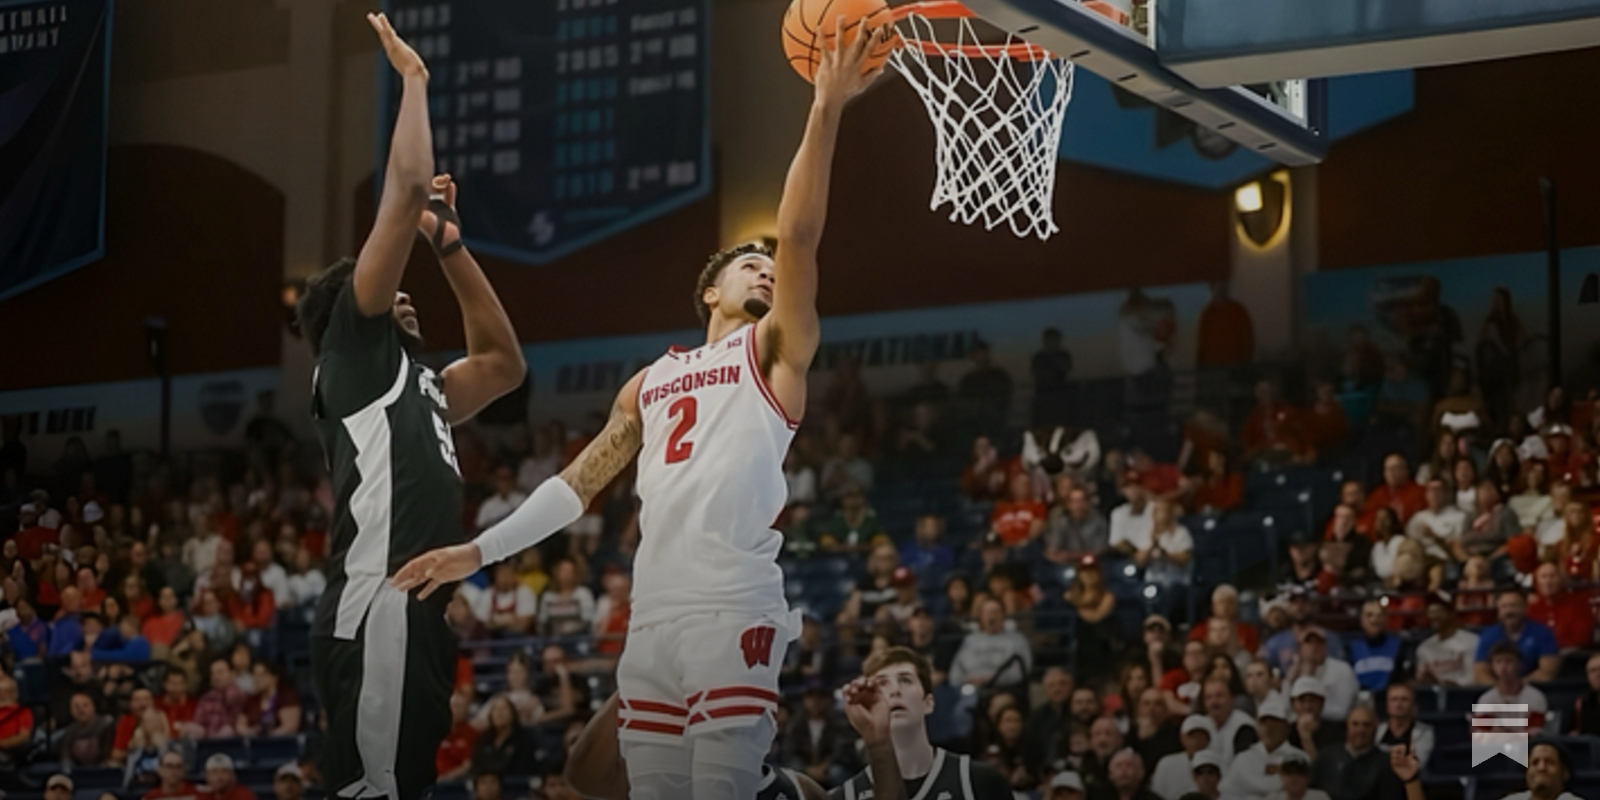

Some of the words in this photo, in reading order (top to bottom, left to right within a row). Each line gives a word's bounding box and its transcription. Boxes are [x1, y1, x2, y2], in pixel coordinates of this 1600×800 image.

[641, 364, 740, 409] WISCONSIN
[665, 395, 697, 464] 2
[741, 626, 776, 669] W
